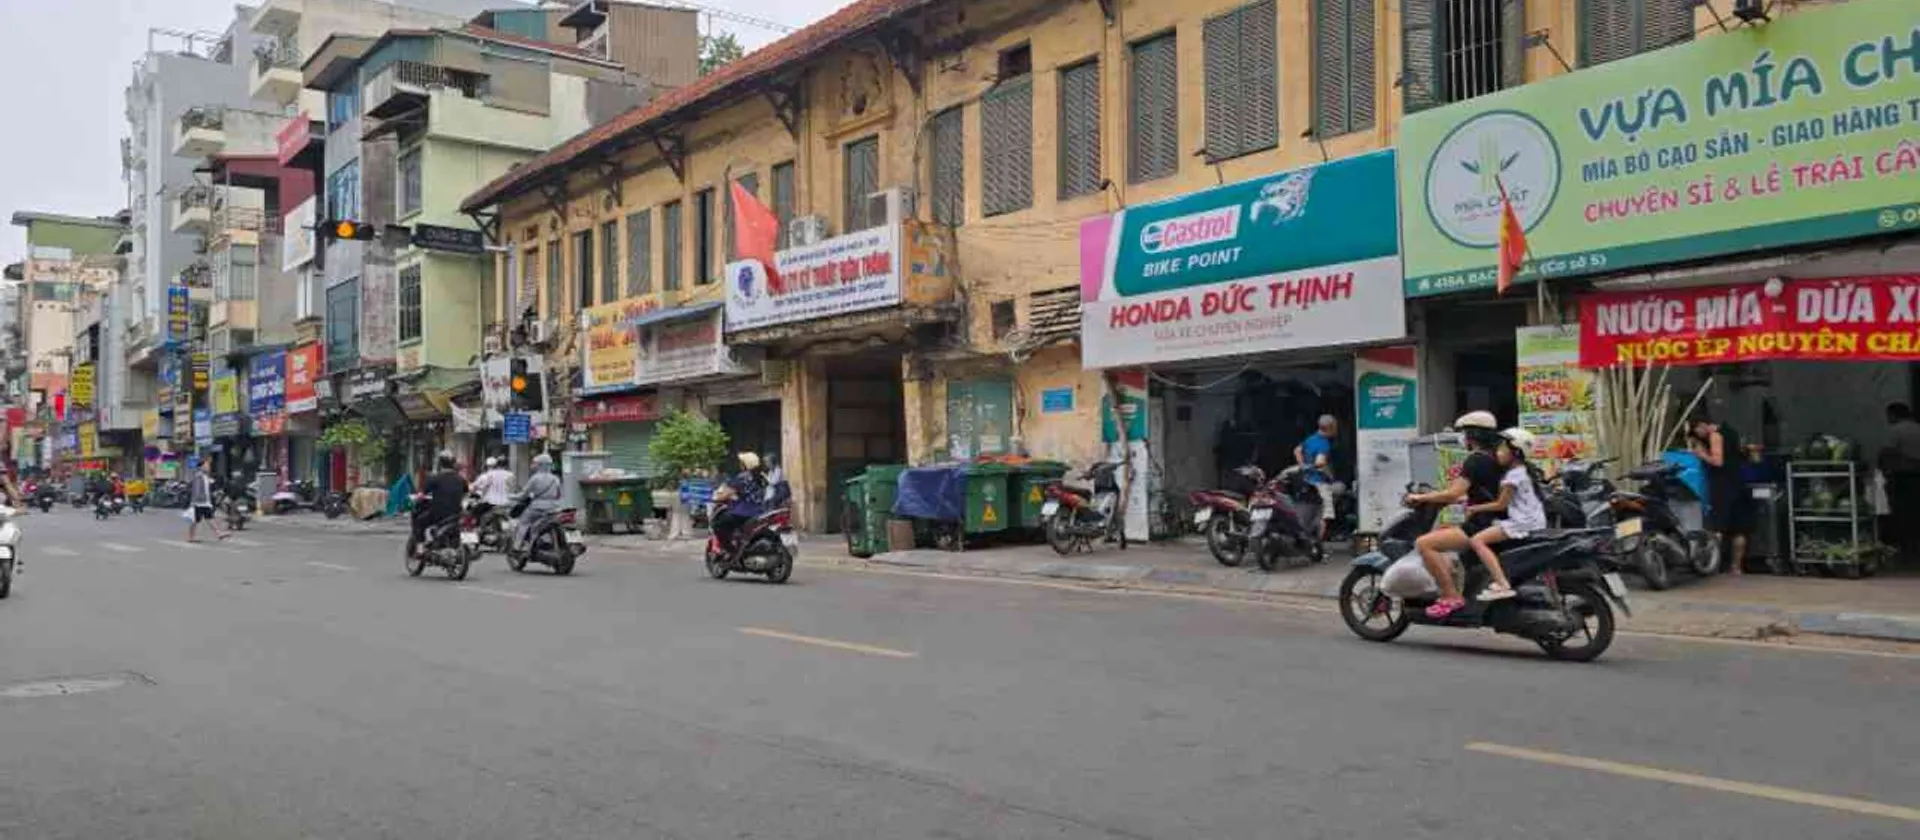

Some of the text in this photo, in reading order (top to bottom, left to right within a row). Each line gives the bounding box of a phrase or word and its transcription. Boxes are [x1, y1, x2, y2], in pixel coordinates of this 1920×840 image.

[1578, 86, 1687, 143] VỰA
[1706, 51, 1822, 117] MÍA
[1581, 155, 1618, 182] MÍA
[1657, 143, 1698, 171] CẠO
[1771, 117, 1825, 147] GIAO
[1832, 104, 1901, 136] HÀNG
[1584, 185, 1679, 223] CHUYÊN
[1723, 177, 1741, 202] &
[1791, 152, 1865, 189] TRÁI
[1164, 208, 1234, 248] Castrol
[1142, 246, 1242, 278] BIKE POINT
[1469, 271, 1498, 288] BẠC
[1109, 271, 1355, 330] HONDA ĐỨC THỊNH
[1596, 295, 1684, 337] NƯỚC
[1695, 288, 1763, 331] MÍA
[1797, 280, 1875, 324] DỪA
[1887, 285, 1920, 324] X
[1616, 336, 1689, 362] NƯỚC
[1695, 330, 1732, 358] ÉP
[1739, 326, 1859, 355] NGUYÊN
